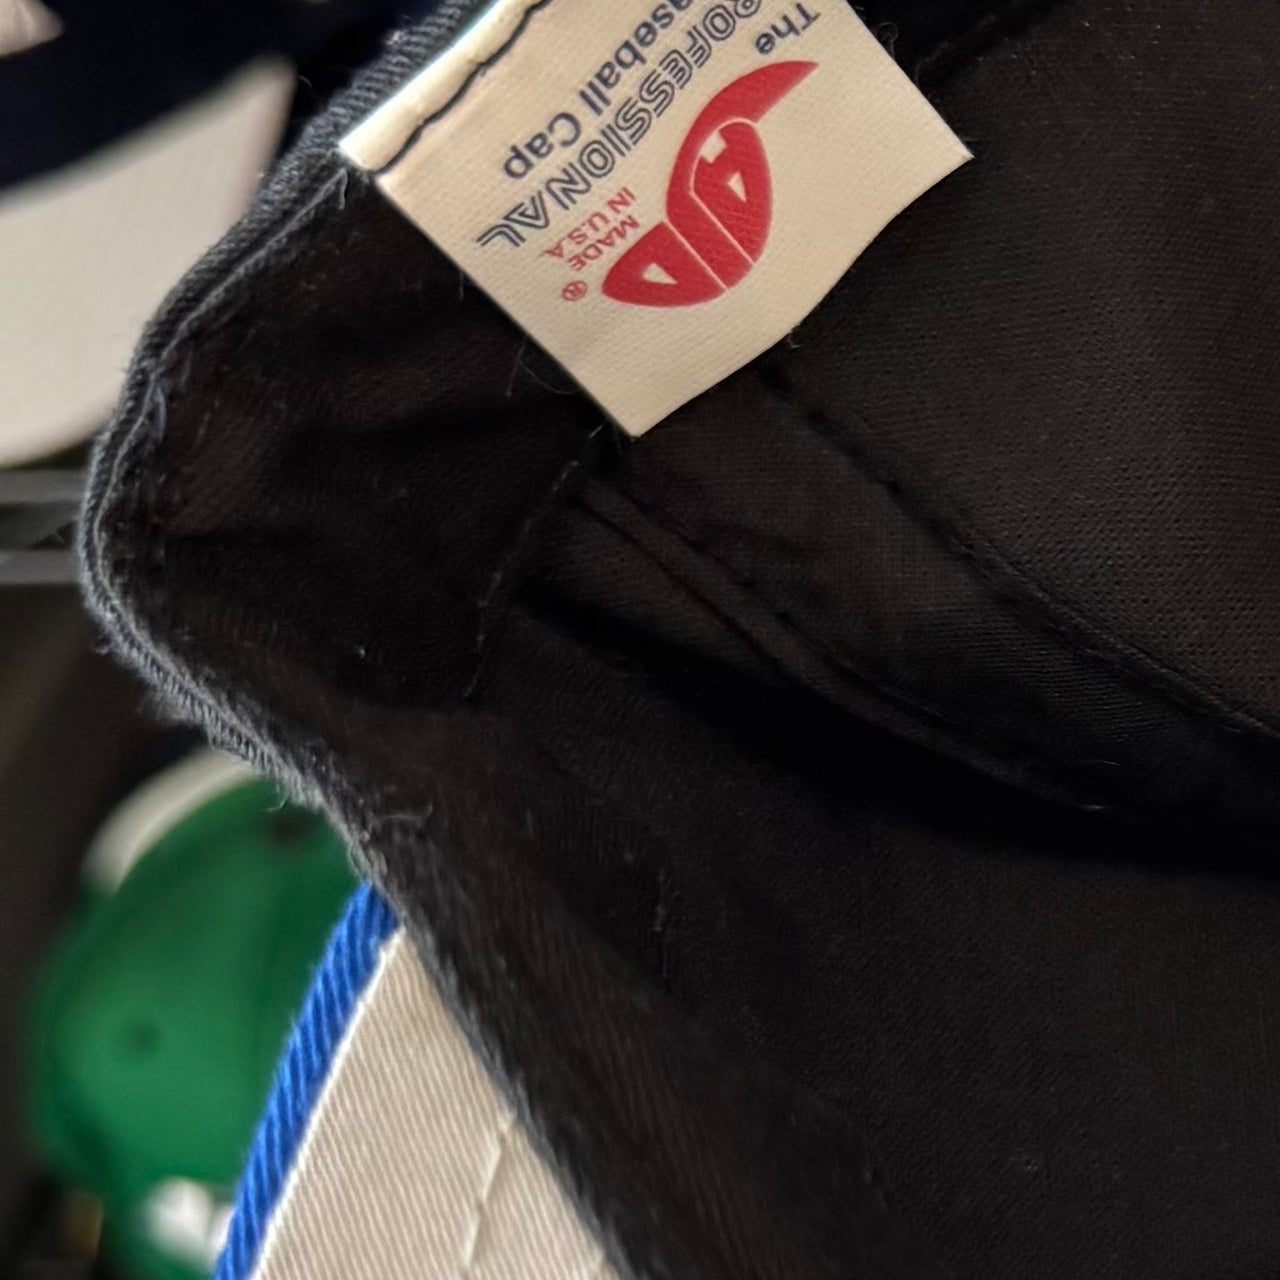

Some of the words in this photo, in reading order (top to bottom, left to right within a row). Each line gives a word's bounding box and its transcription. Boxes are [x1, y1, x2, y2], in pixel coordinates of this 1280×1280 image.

[754, 2, 821, 55] The
[503, 111, 582, 180] Cap
[607, 186, 637, 214] IN
[567, 214, 640, 271] MADE
